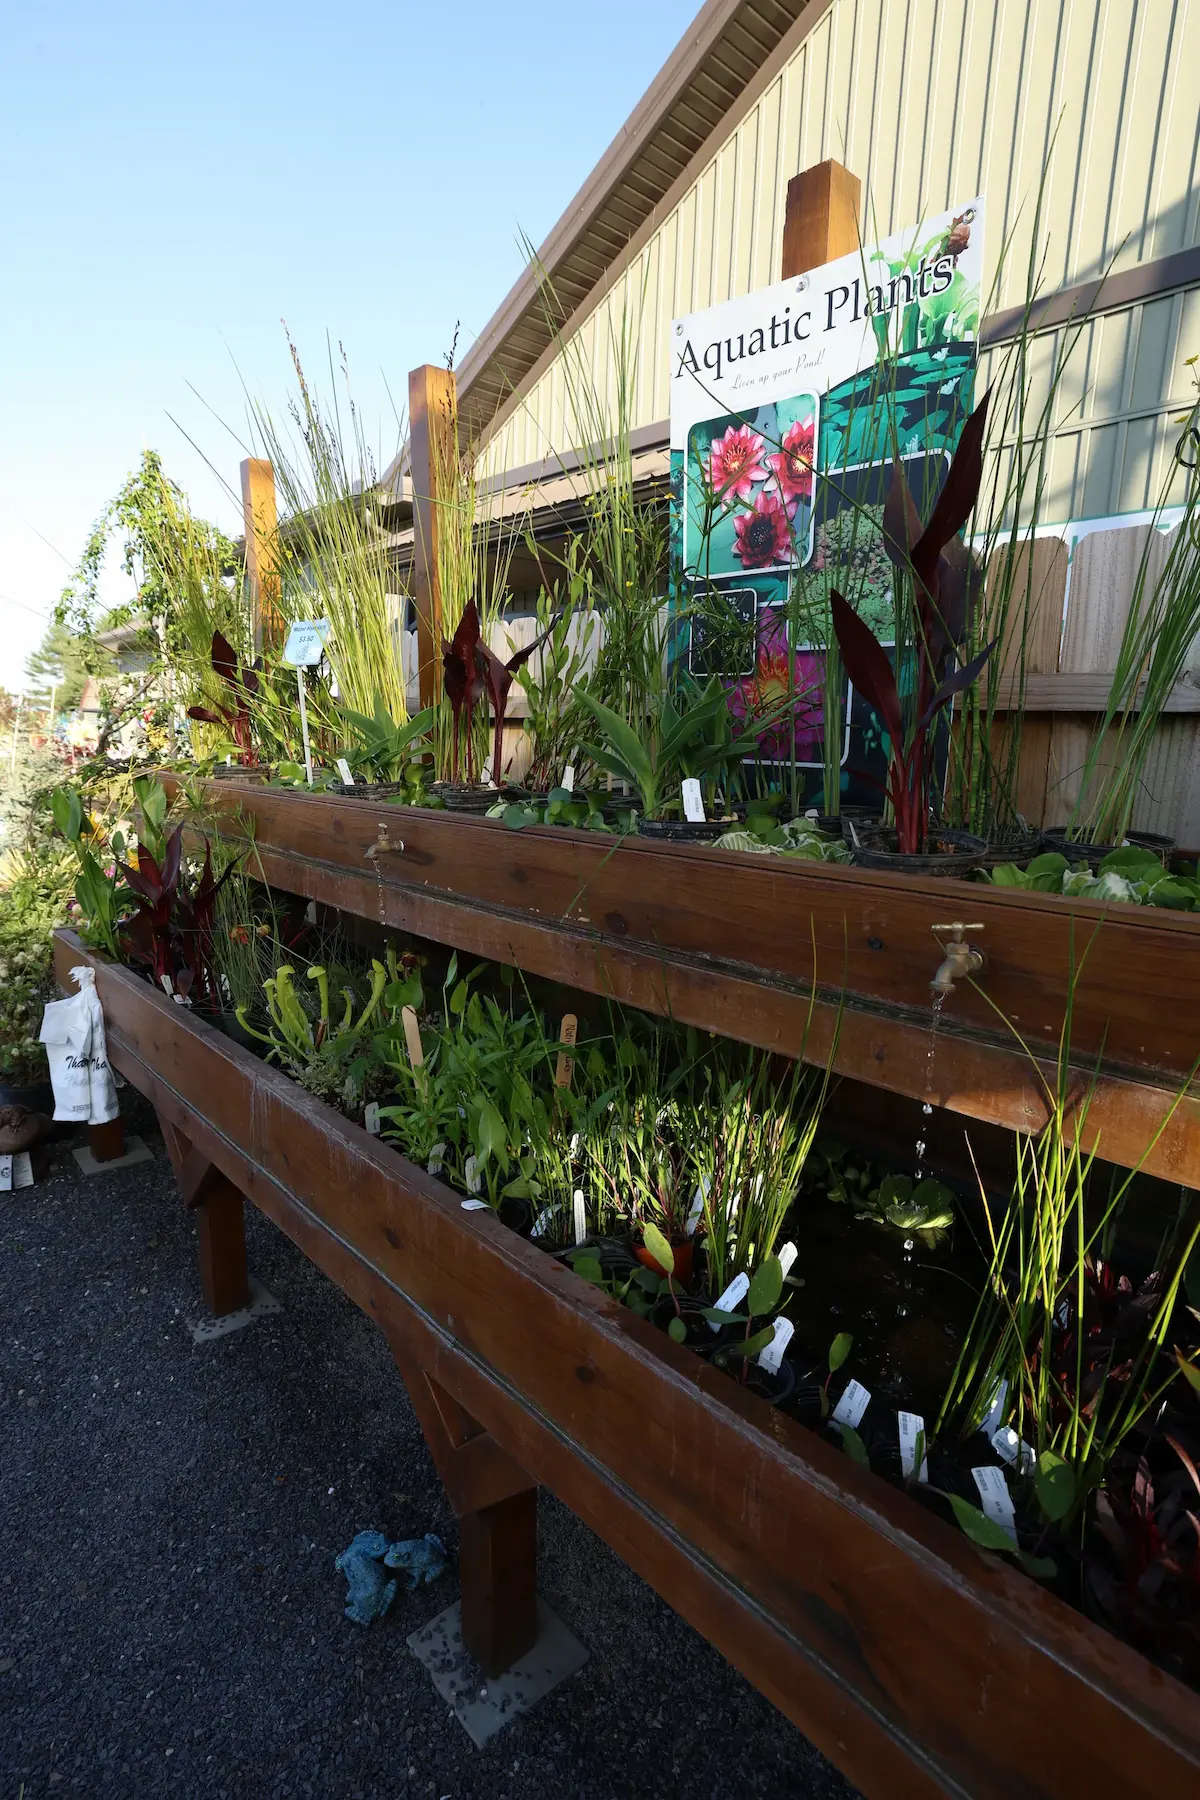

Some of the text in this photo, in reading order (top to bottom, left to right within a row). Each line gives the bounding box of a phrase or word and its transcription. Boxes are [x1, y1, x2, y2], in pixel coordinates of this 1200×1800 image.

[676, 256, 953, 381] Aquatic Plants
[729, 347, 826, 391] Liven up your Pond!
[65, 1055, 89, 1070] Tha
[91, 1057, 108, 1072] Tha
